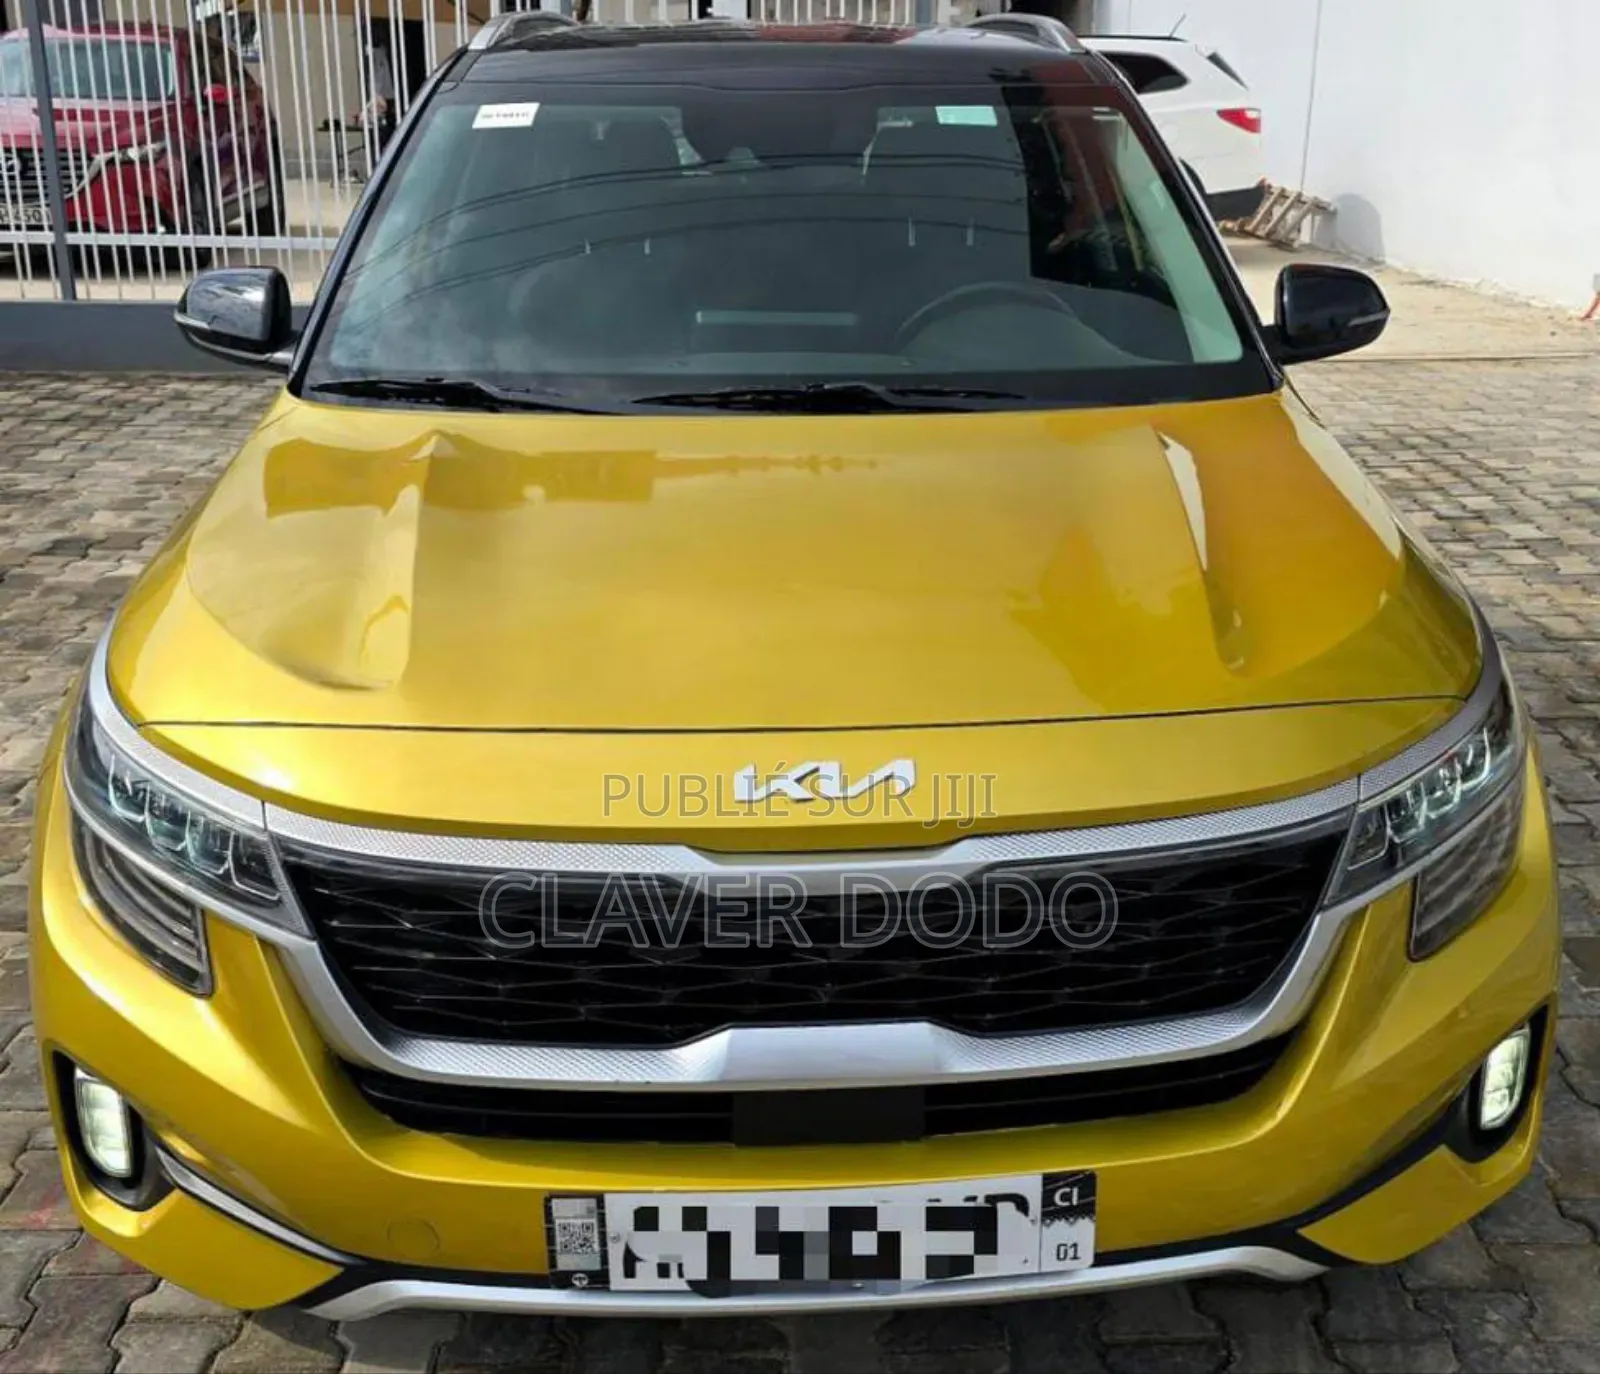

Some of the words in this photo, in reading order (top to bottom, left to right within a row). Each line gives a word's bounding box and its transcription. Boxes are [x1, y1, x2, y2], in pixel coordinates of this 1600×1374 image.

[734, 758, 916, 804] KIA
[1054, 1187, 1079, 1207] CI
[1056, 1242, 1082, 1262] 01
